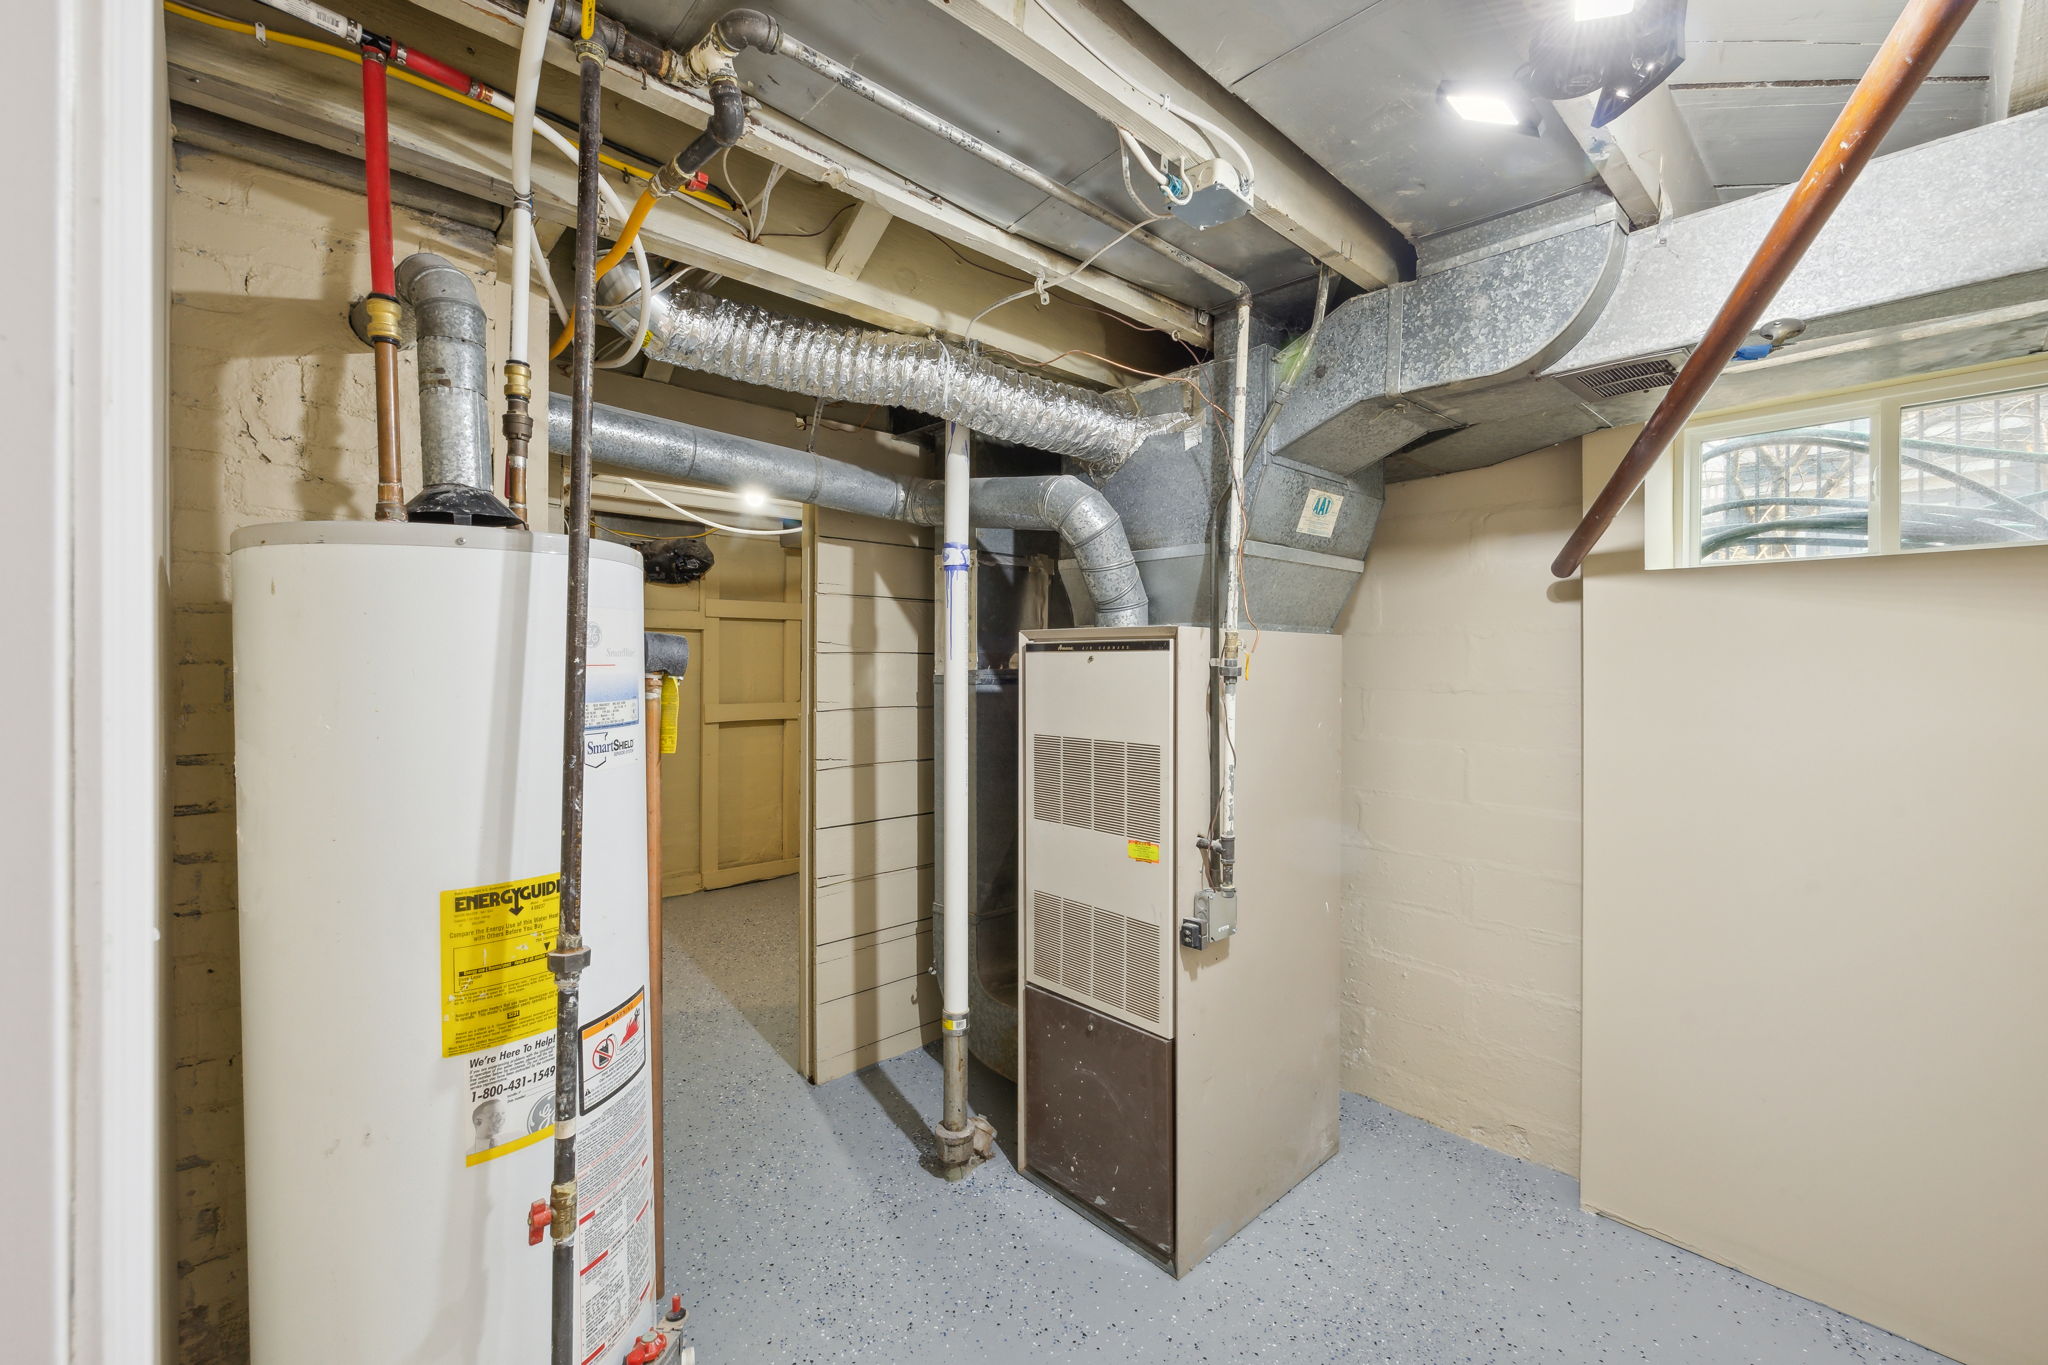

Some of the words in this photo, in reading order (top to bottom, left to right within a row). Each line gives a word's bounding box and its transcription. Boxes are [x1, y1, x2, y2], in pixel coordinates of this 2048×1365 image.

[587, 739, 634, 755] SmartSHIELD
[449, 929, 475, 939] Compare
[475, 927, 484, 935] the
[486, 924, 504, 934] Energy
[474, 934, 486, 942] with
[487, 931, 504, 939] Others
[506, 927, 522, 936] Before
[611, 1003, 634, 1023] WARNING
[470, 1056, 496, 1069] We're
[500, 1049, 520, 1061] Here
[524, 1043, 532, 1053] To
[535, 1034, 556, 1049] Help!
[472, 1065, 556, 1102] 1-800-431-1549
